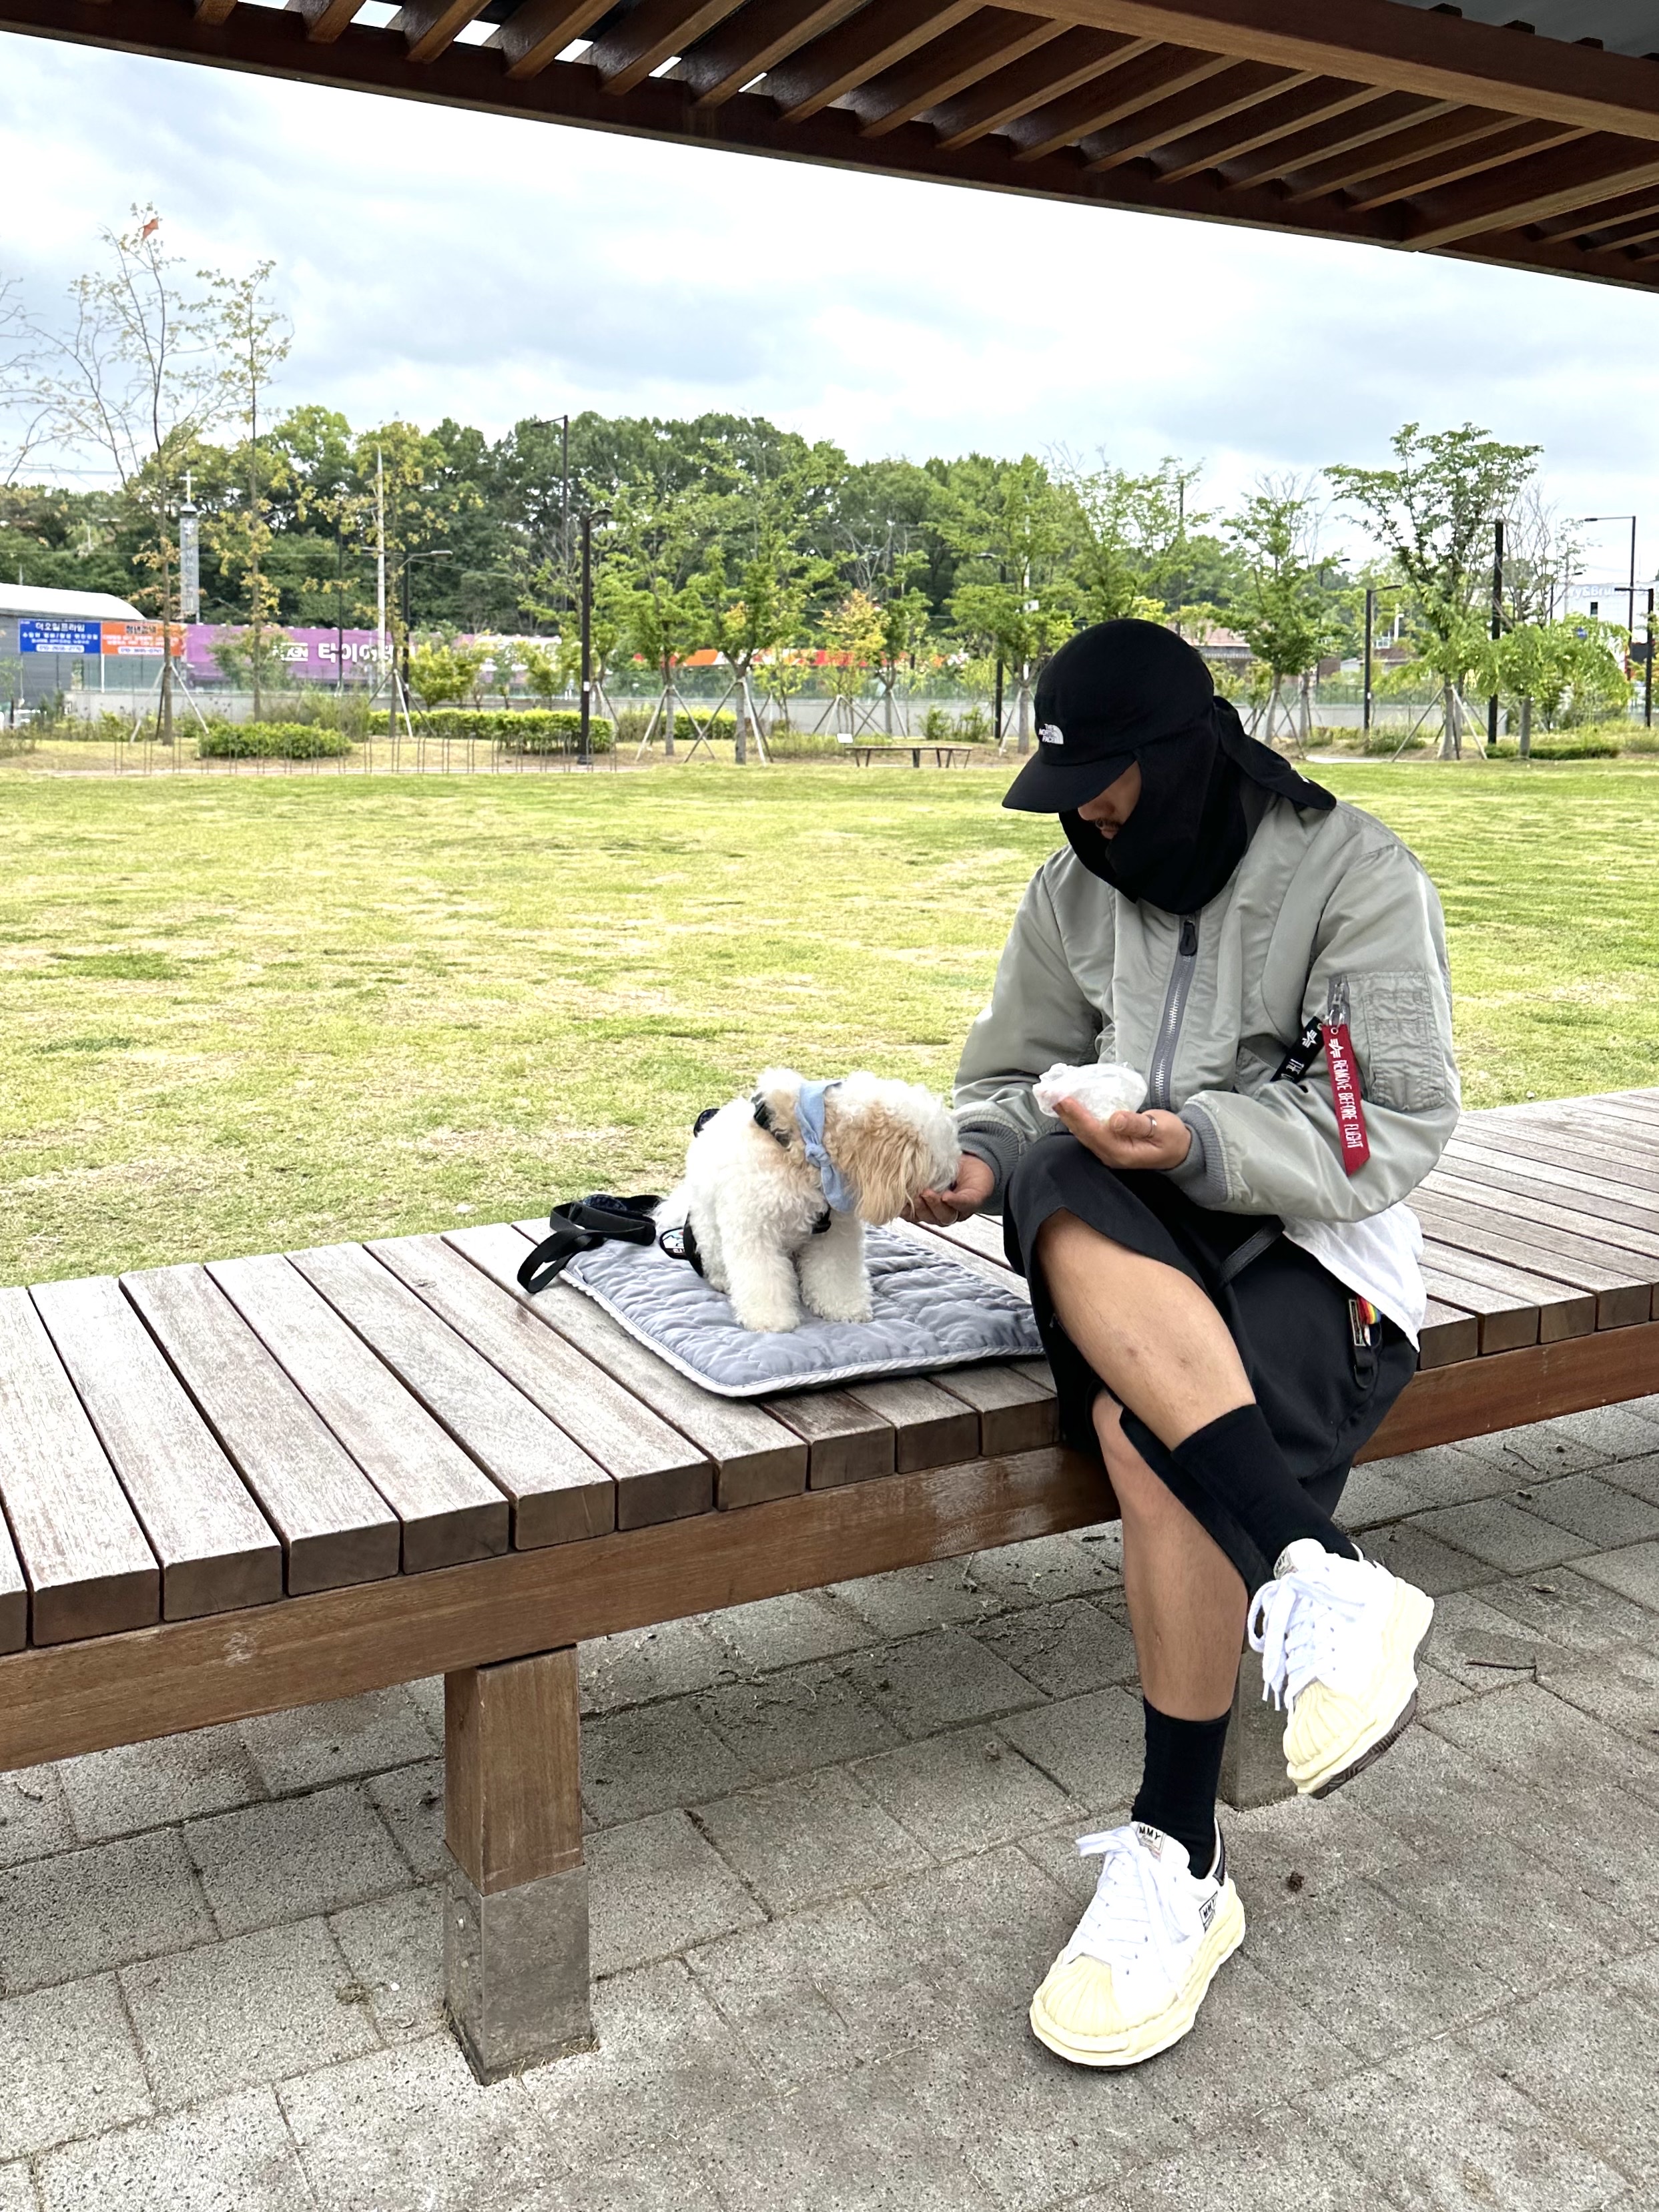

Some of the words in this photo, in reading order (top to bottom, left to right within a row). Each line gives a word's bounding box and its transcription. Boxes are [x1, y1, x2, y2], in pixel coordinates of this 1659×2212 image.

[1333, 1060, 1352, 1090] REMOVE
[1338, 1092, 1357, 1120] BEFORE
[1344, 1124, 1363, 1148] FLIGHT
[1138, 1826, 1161, 1840] MMY
